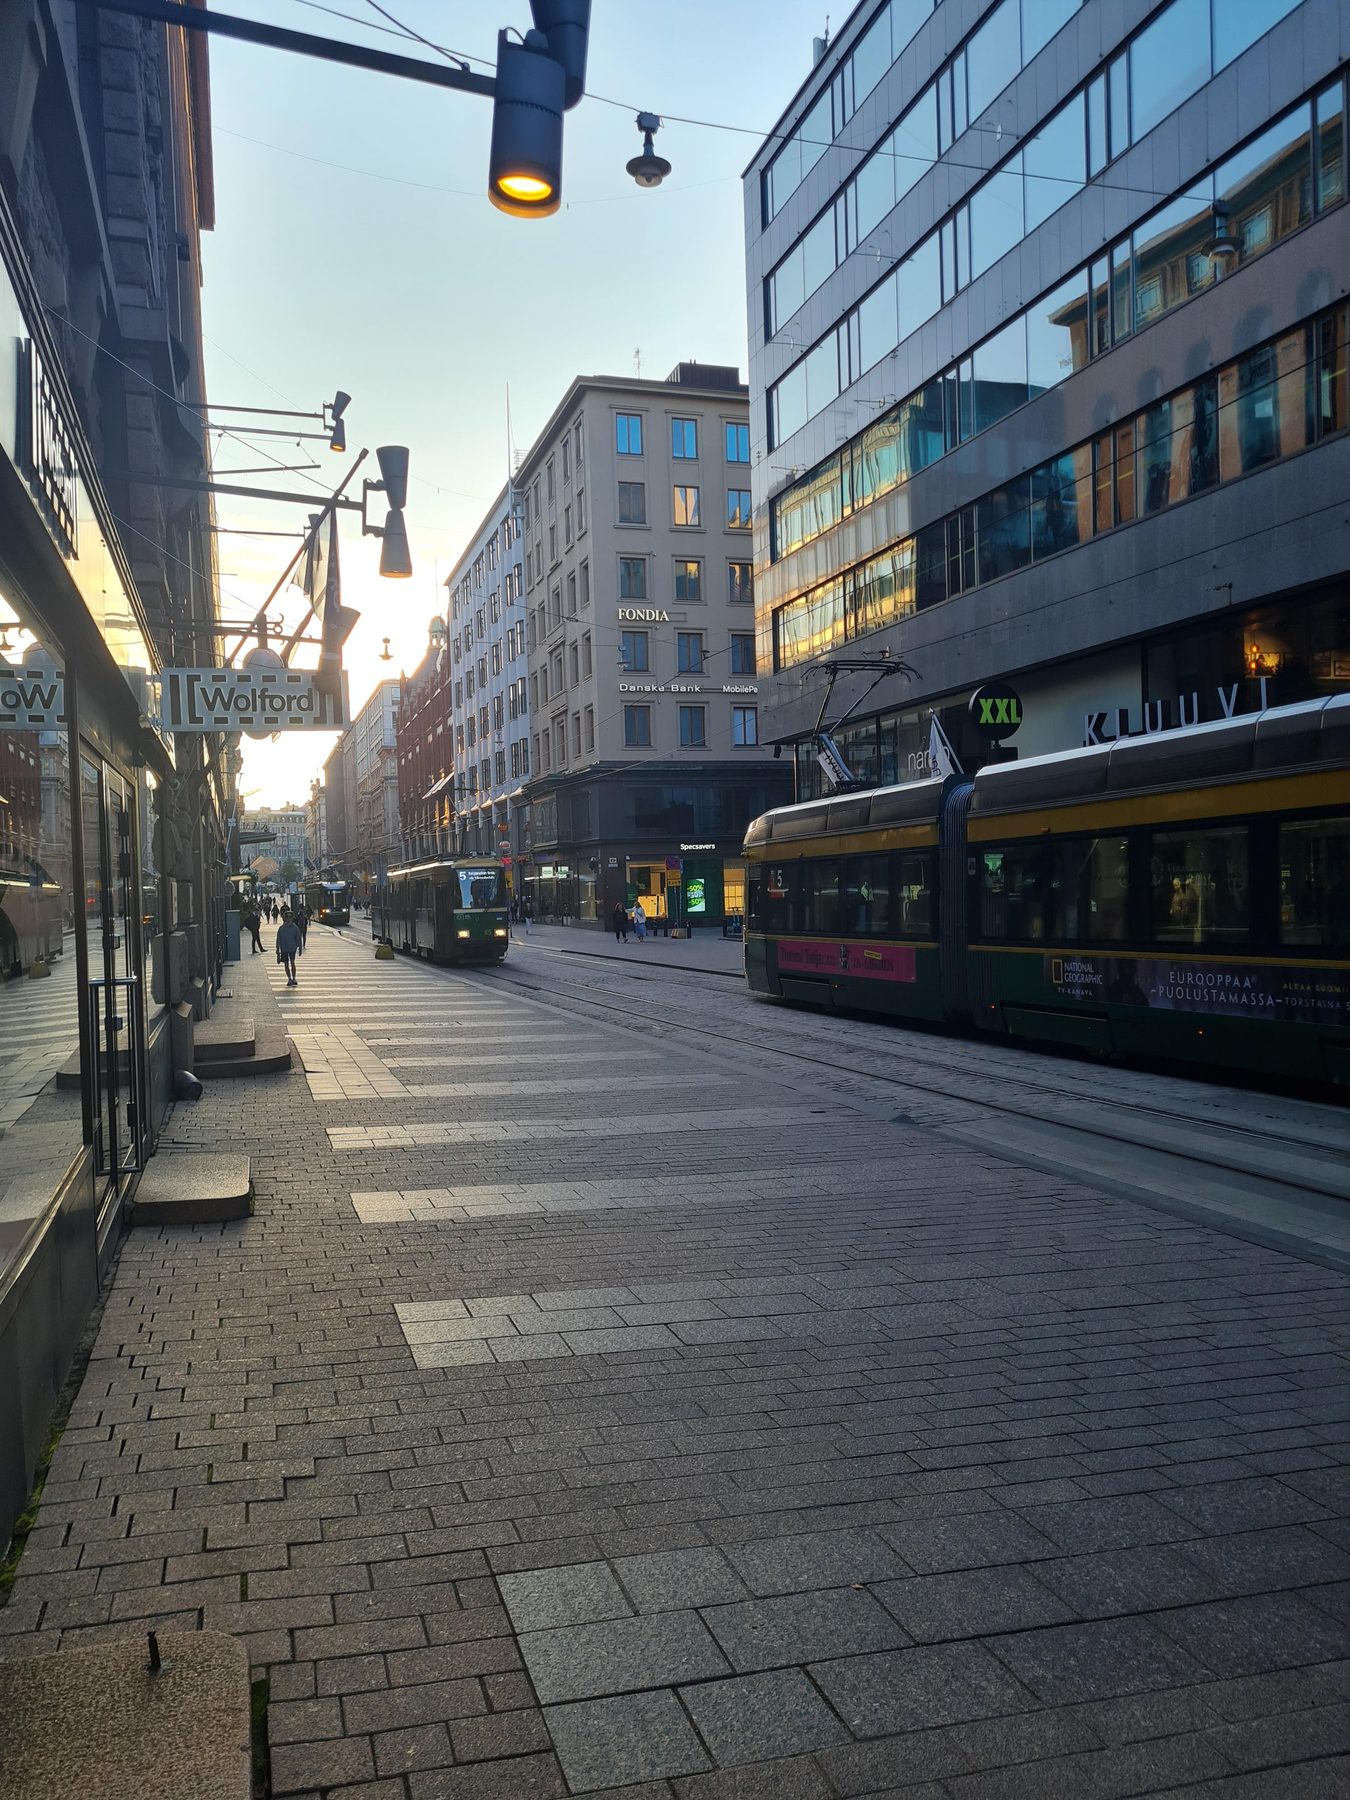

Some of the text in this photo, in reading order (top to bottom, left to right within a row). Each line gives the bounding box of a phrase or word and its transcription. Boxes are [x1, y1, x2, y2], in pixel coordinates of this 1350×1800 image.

[618, 608, 670, 622] FONDIA
[671, 684, 701, 693] Bank
[200, 687, 314, 712] Wolford
[979, 698, 1022, 724] XXL
[1085, 676, 1268, 745] KLUUVI
[680, 843, 716, 852] Specsavers
[459, 871, 467, 881] 5
[1064, 962, 1094, 973] NATIONAL
[1064, 973, 1103, 985] GEOGRAPHIC
[1170, 971, 1252, 989] EUROOPPAA
